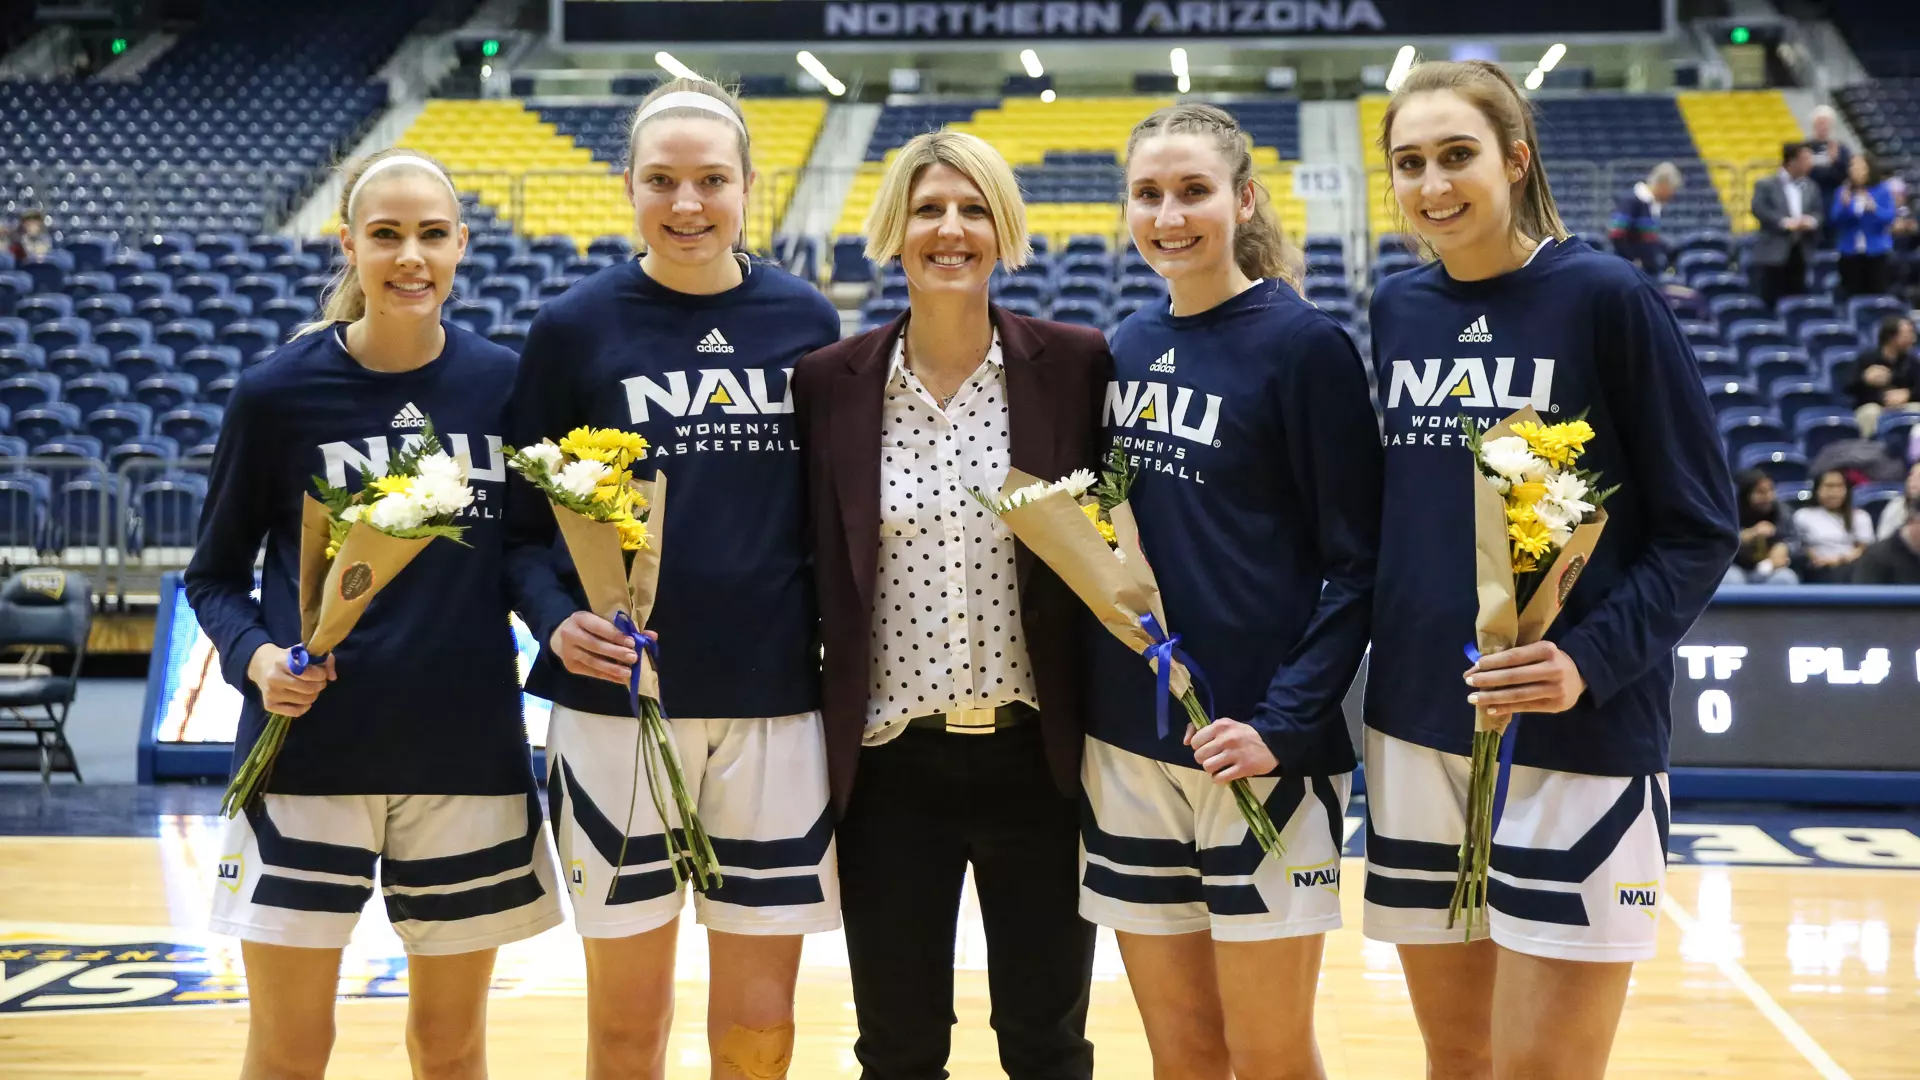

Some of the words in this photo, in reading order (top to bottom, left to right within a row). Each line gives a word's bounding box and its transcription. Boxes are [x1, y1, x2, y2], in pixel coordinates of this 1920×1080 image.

[825, 2, 1121, 35] NORTHERN
[1133, 0, 1386, 32] ARIZONA
[1457, 332, 1493, 343] adidas
[696, 343, 735, 353] adidas
[1149, 361, 1176, 374] adidas
[1387, 357, 1556, 412] NAU
[620, 367, 795, 425] NAU
[391, 418, 426, 428] adida
[1101, 380, 1223, 446] NAU
[675, 423, 779, 437] WOMEN'S
[1678, 646, 1748, 679] TF
[1788, 646, 1892, 685] PL#
[1697, 688, 1733, 734] 0
[1293, 868, 1336, 888] NAU
[1620, 889, 1656, 906] NAU
